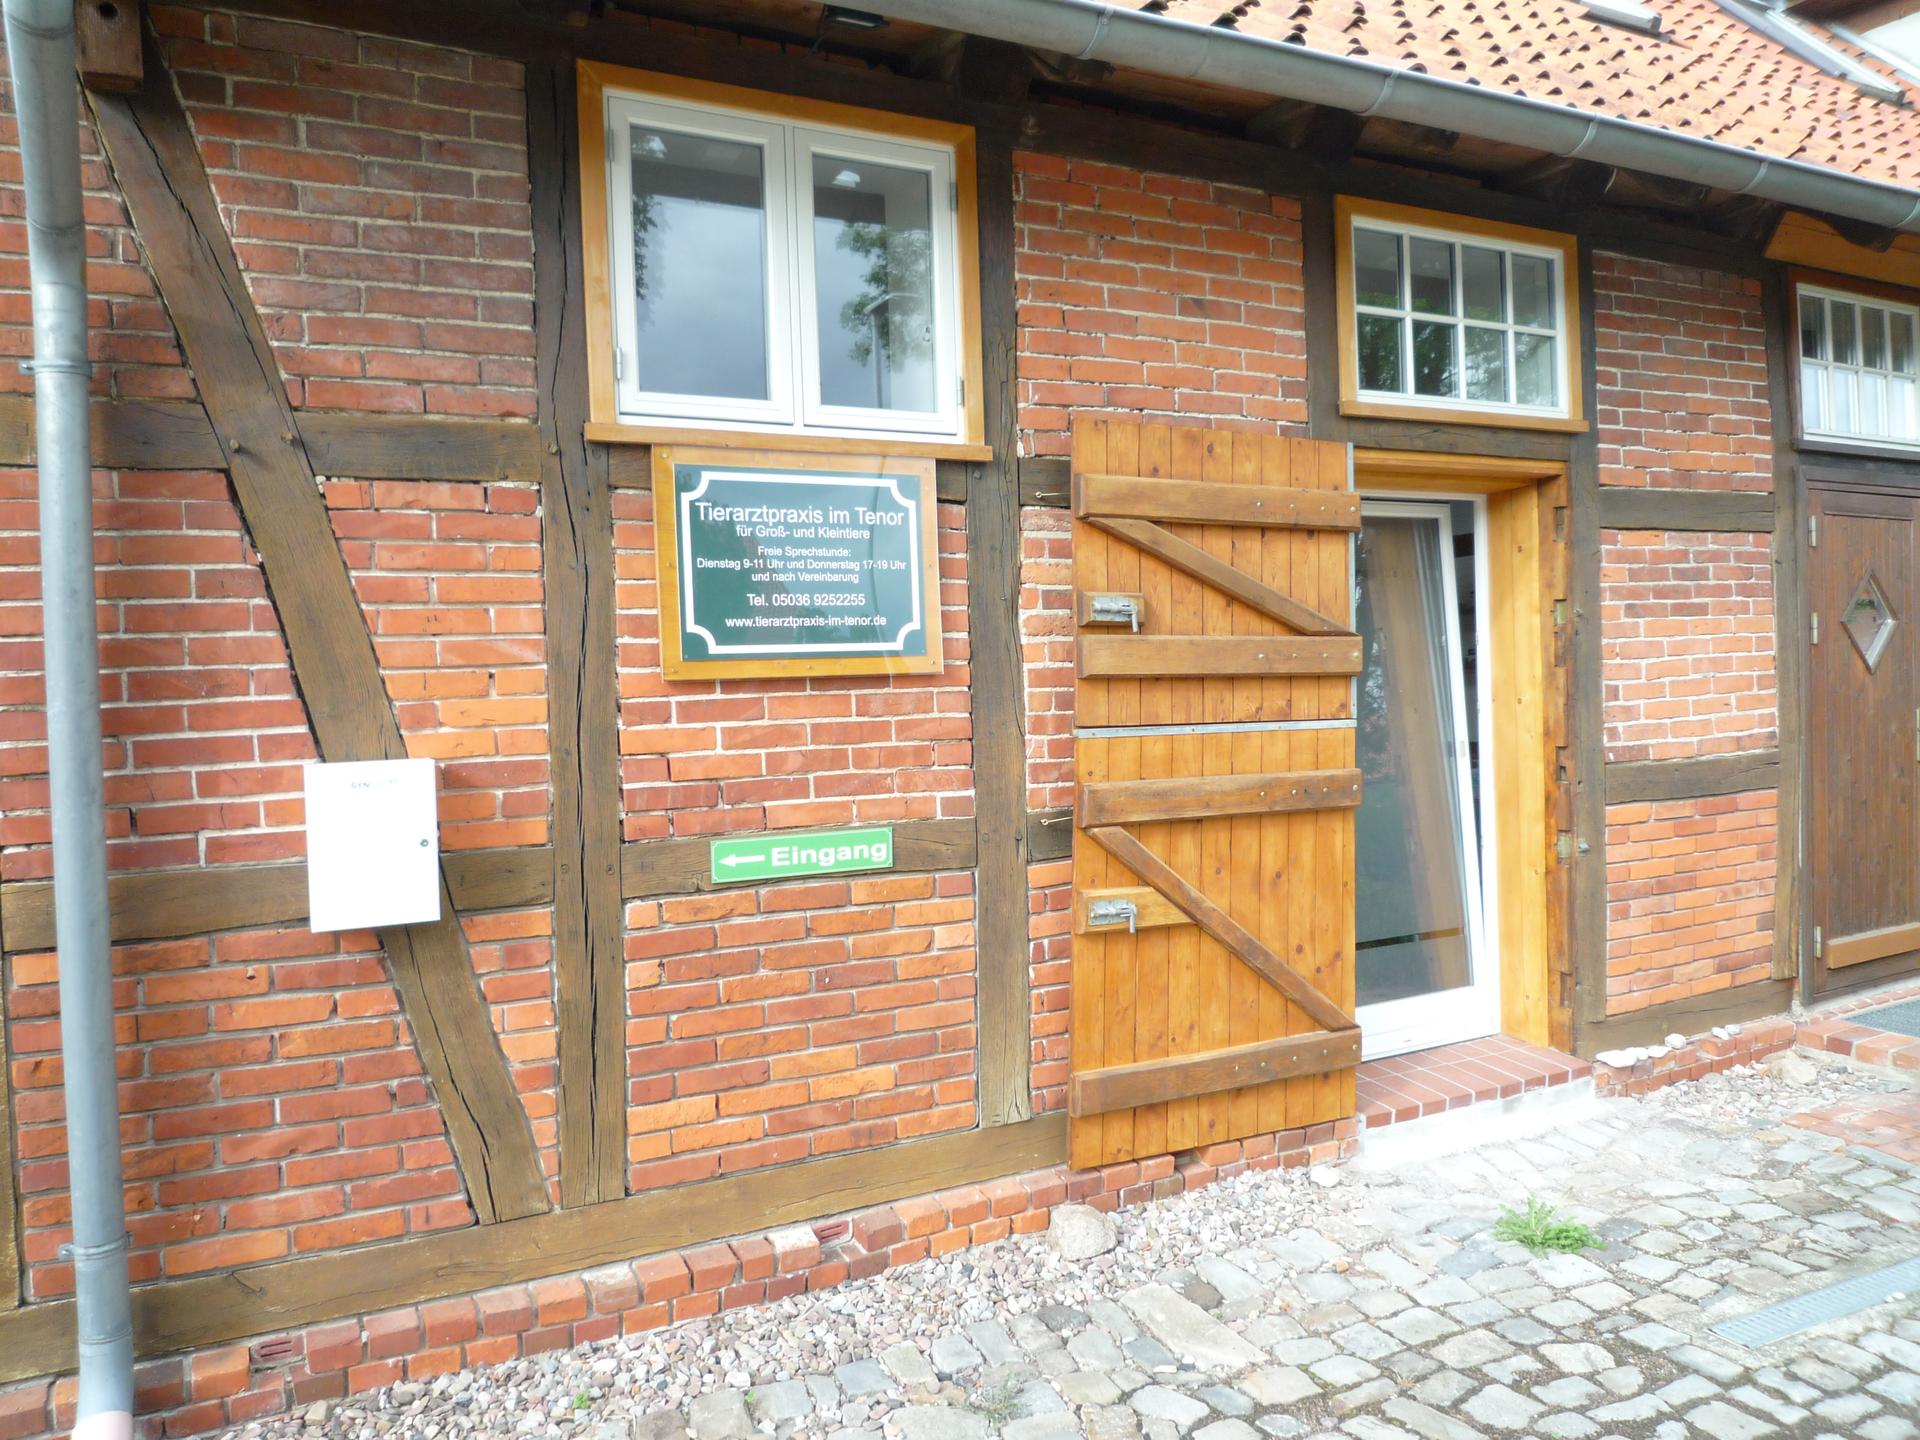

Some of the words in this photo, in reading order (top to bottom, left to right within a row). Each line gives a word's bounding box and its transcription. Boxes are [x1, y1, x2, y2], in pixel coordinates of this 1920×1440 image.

[695, 502, 824, 527] Tierarztpraxis
[828, 505, 850, 525] im
[854, 507, 905, 525] Tenor
[736, 525, 753, 537] für
[755, 526, 790, 539] Groß-
[793, 526, 815, 539] und
[818, 526, 870, 540] Kleintiere
[757, 546, 783, 557] Freie
[784, 546, 852, 558] Sprechstunde:
[697, 559, 741, 570] Dienstag
[743, 559, 764, 569] 9-11
[766, 559, 785, 569] Uhr
[786, 559, 805, 569] und
[806, 559, 860, 571] Donnerstag
[862, 560, 889, 570] 17-19
[890, 560, 906, 570] Uhr
[751, 572, 770, 582] und
[772, 572, 796, 582] nach
[799, 572, 859, 584] Vereinbarung
[746, 593, 769, 607] Tel.
[772, 593, 811, 607] 05036
[813, 593, 865, 607] 9252255
[725, 614, 887, 630] www.tierarztpraxis-im-tenor.de
[771, 843, 887, 866] Eingang
